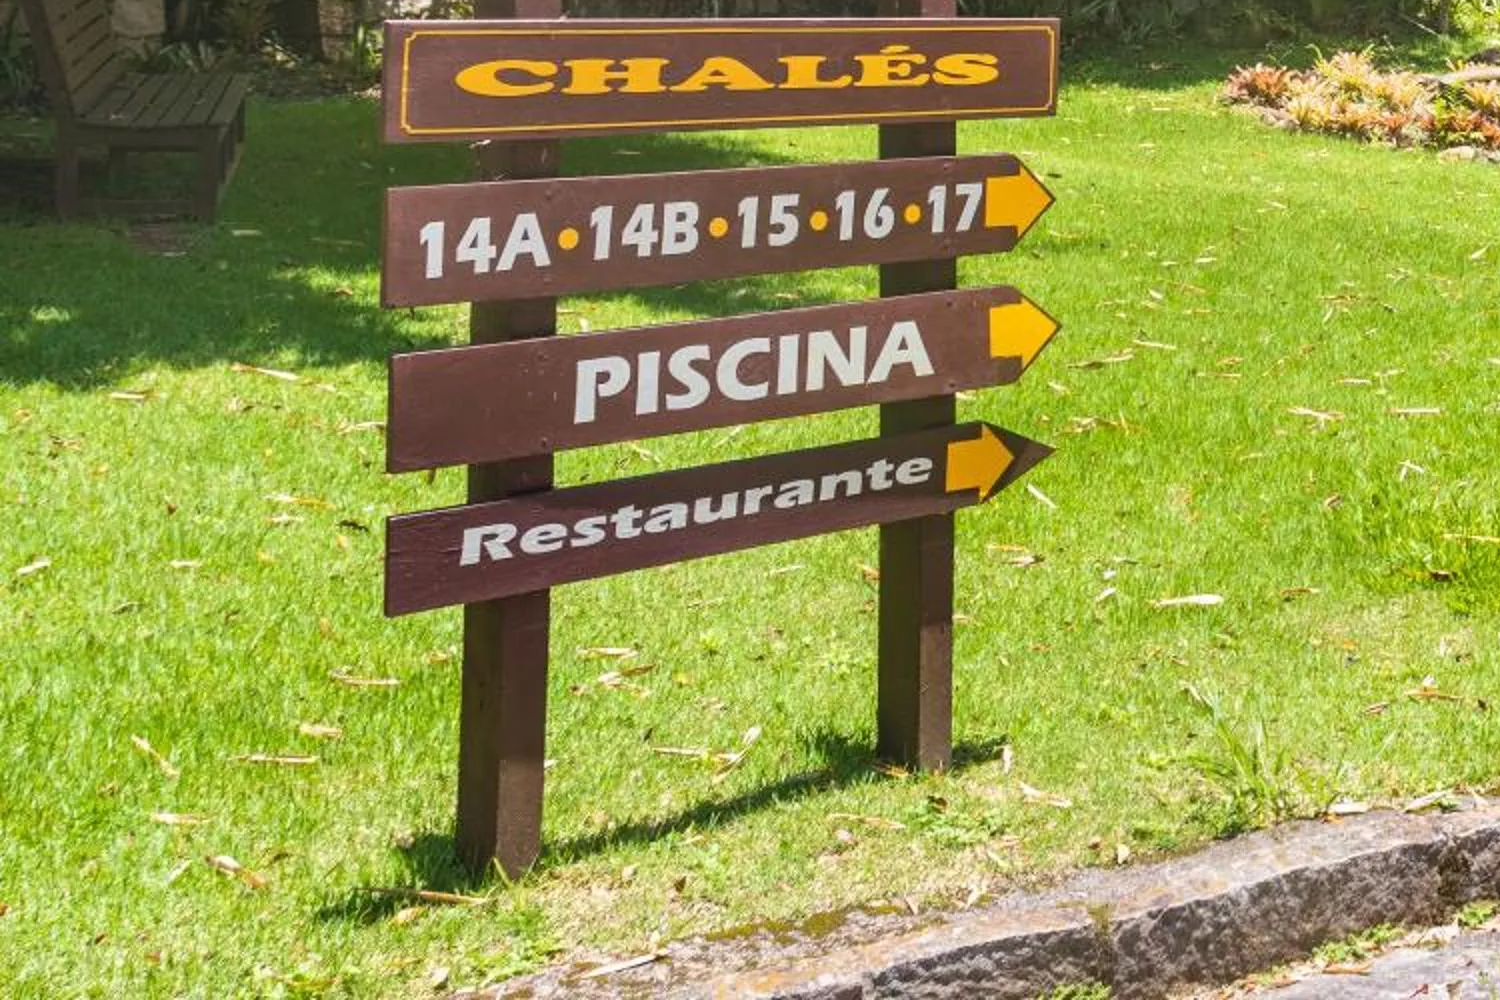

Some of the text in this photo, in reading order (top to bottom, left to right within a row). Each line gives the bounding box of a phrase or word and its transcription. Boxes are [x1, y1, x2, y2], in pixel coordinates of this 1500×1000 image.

[454, 44, 1000, 97] CHALÉS
[418, 181, 984, 281] 14A 14B 15 16 17
[572, 318, 936, 426] PISCINA
[458, 456, 935, 567] Restaurante
